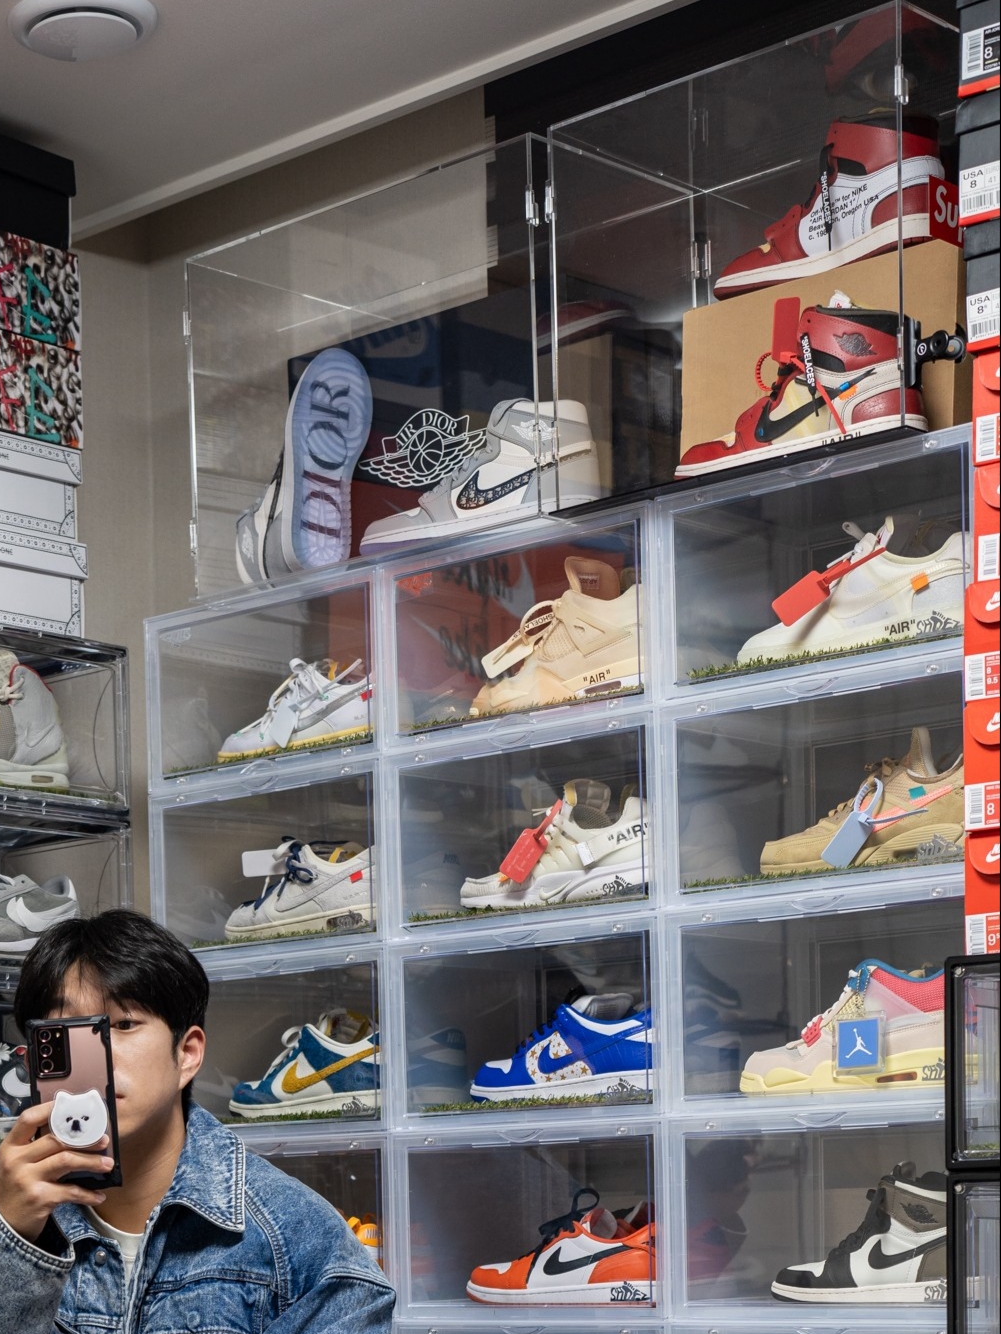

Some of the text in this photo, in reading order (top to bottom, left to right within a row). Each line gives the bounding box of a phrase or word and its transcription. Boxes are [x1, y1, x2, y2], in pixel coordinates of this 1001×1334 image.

[984, 46, 993, 59] 8
[963, 169, 984, 181] USA
[970, 180, 977, 188] 8
[841, 193, 851, 203] for
[851, 183, 868, 197] NIKE
[841, 204, 862, 220] Oregon
[863, 194, 879, 207] USA
[934, 185, 960, 236] Su
[816, 228, 828, 239] 198
[970, 295, 990, 306] USA
[801, 335, 815, 388] "SHOELACES"
[395, 411, 458, 450] AIR DIOR
[301, 379, 350, 540] DIOR
[884, 619, 916, 636] "AIR"
[583, 669, 611, 685] "AIR"
[986, 803, 995, 816] 8
[607, 822, 649, 845] "AIR"
